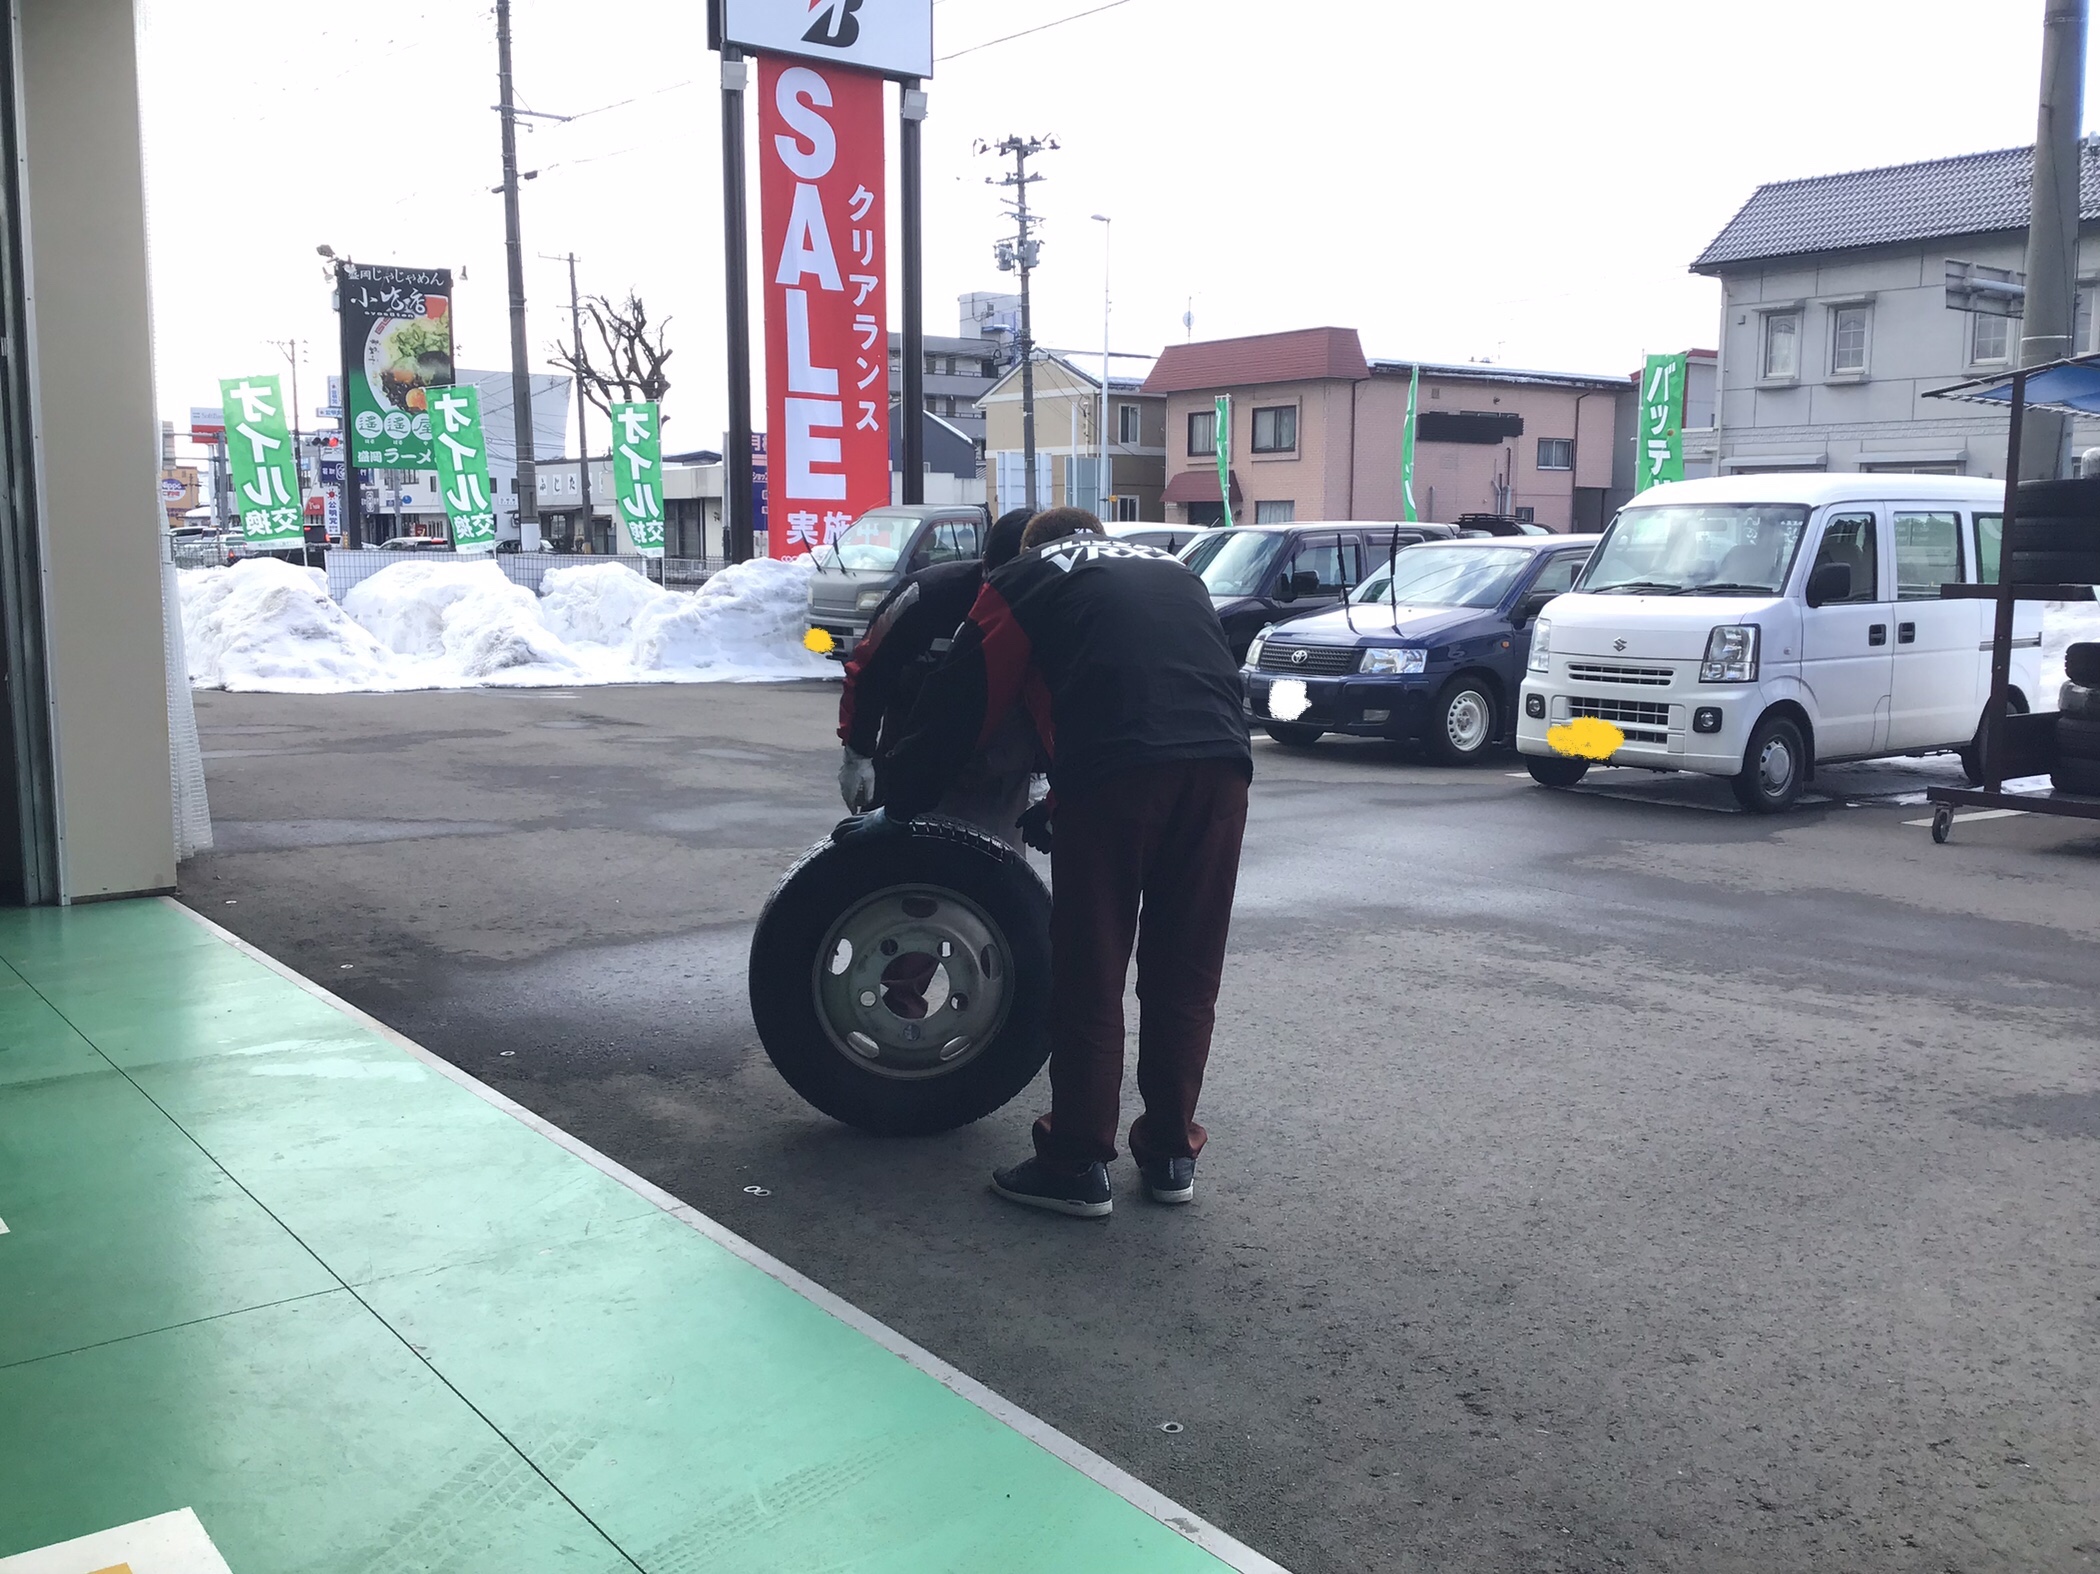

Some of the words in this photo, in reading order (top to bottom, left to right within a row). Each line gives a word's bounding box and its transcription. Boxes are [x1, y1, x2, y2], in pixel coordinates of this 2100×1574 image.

[774, 66, 846, 500] SALE
[848, 184, 879, 432] クリアランス
[201, 411, 224, 419] SoftBan
[357, 447, 437, 465] 盛岡ラーメ
[1646, 361, 1676, 486] バッテ
